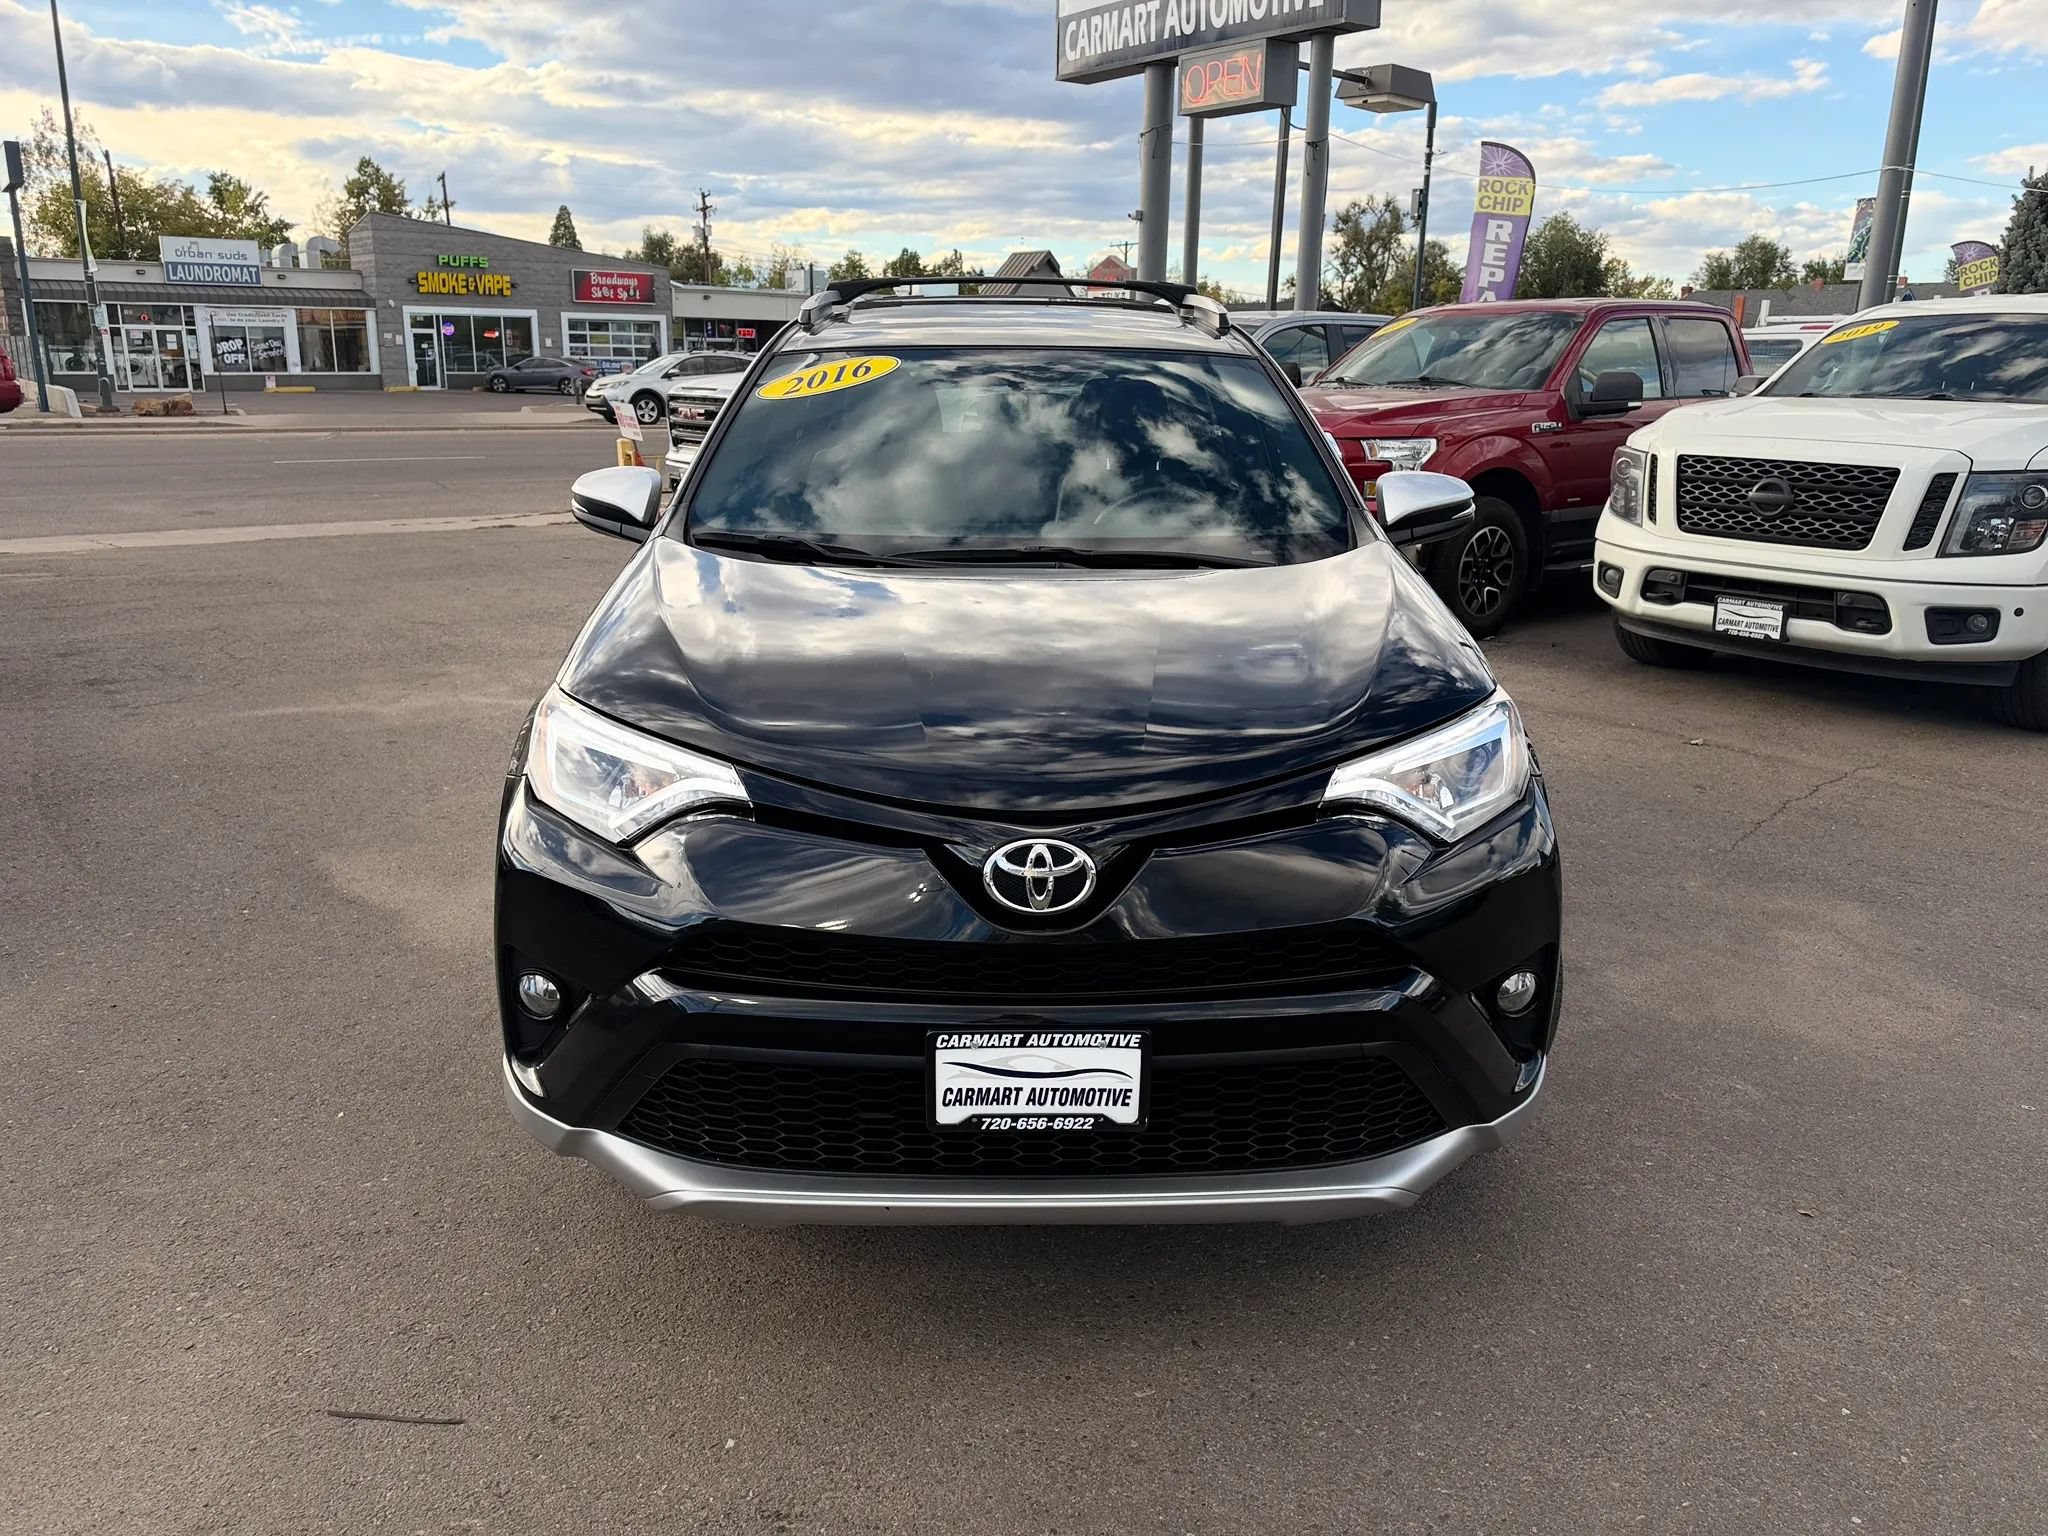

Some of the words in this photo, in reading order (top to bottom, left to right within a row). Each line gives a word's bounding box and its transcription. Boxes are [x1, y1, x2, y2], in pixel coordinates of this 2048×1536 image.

[1064, 2, 1161, 62] CARMART
[1163, 0, 1324, 39] AUTOM
[1185, 52, 1264, 104] OPEN
[1478, 178, 1529, 196] ROCK
[1478, 195, 1524, 212] CHIP
[217, 251, 248, 261] suds
[437, 254, 489, 268] PUFFS
[168, 263, 257, 283] LAUNDROMAT
[1960, 258, 1998, 278] ROCK
[417, 271, 467, 295] SMOKE
[468, 277, 476, 291] &
[476, 273, 512, 297] VAPE
[590, 271, 638, 288] Broadways
[1963, 270, 1997, 287] CHIP
[216, 338, 244, 355] DROP
[224, 353, 245, 364] OFF
[782, 358, 874, 397] 2016
[1746, 601, 1783, 610] AUTOMOTIVE
[1718, 618, 1744, 628] CARMART
[1745, 621, 1779, 632] AUTOMOTIVE
[936, 1033, 1024, 1048] CARMART
[1026, 1033, 1141, 1048] AUTOMOTIVE
[941, 1086, 1023, 1107] CARMART
[1024, 1086, 1133, 1107] AUTOMOTIVE
[980, 1117, 1095, 1130] 720-656-6922
